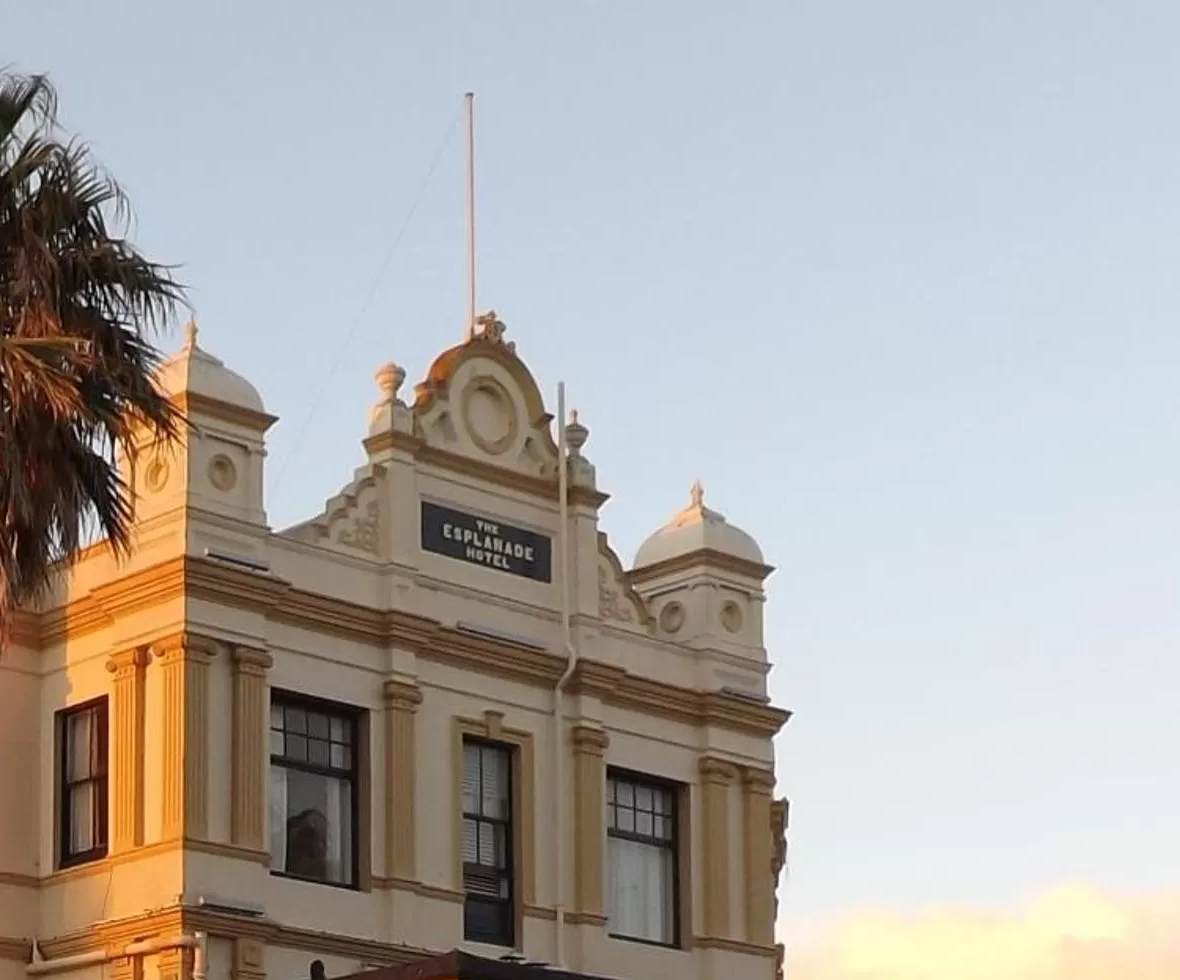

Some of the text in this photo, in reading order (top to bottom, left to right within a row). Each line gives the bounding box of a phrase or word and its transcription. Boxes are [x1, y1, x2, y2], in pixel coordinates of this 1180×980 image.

[475, 520, 500, 535] THE
[442, 523, 534, 561] ESPLANADE
[465, 546, 510, 569] HOTEL
